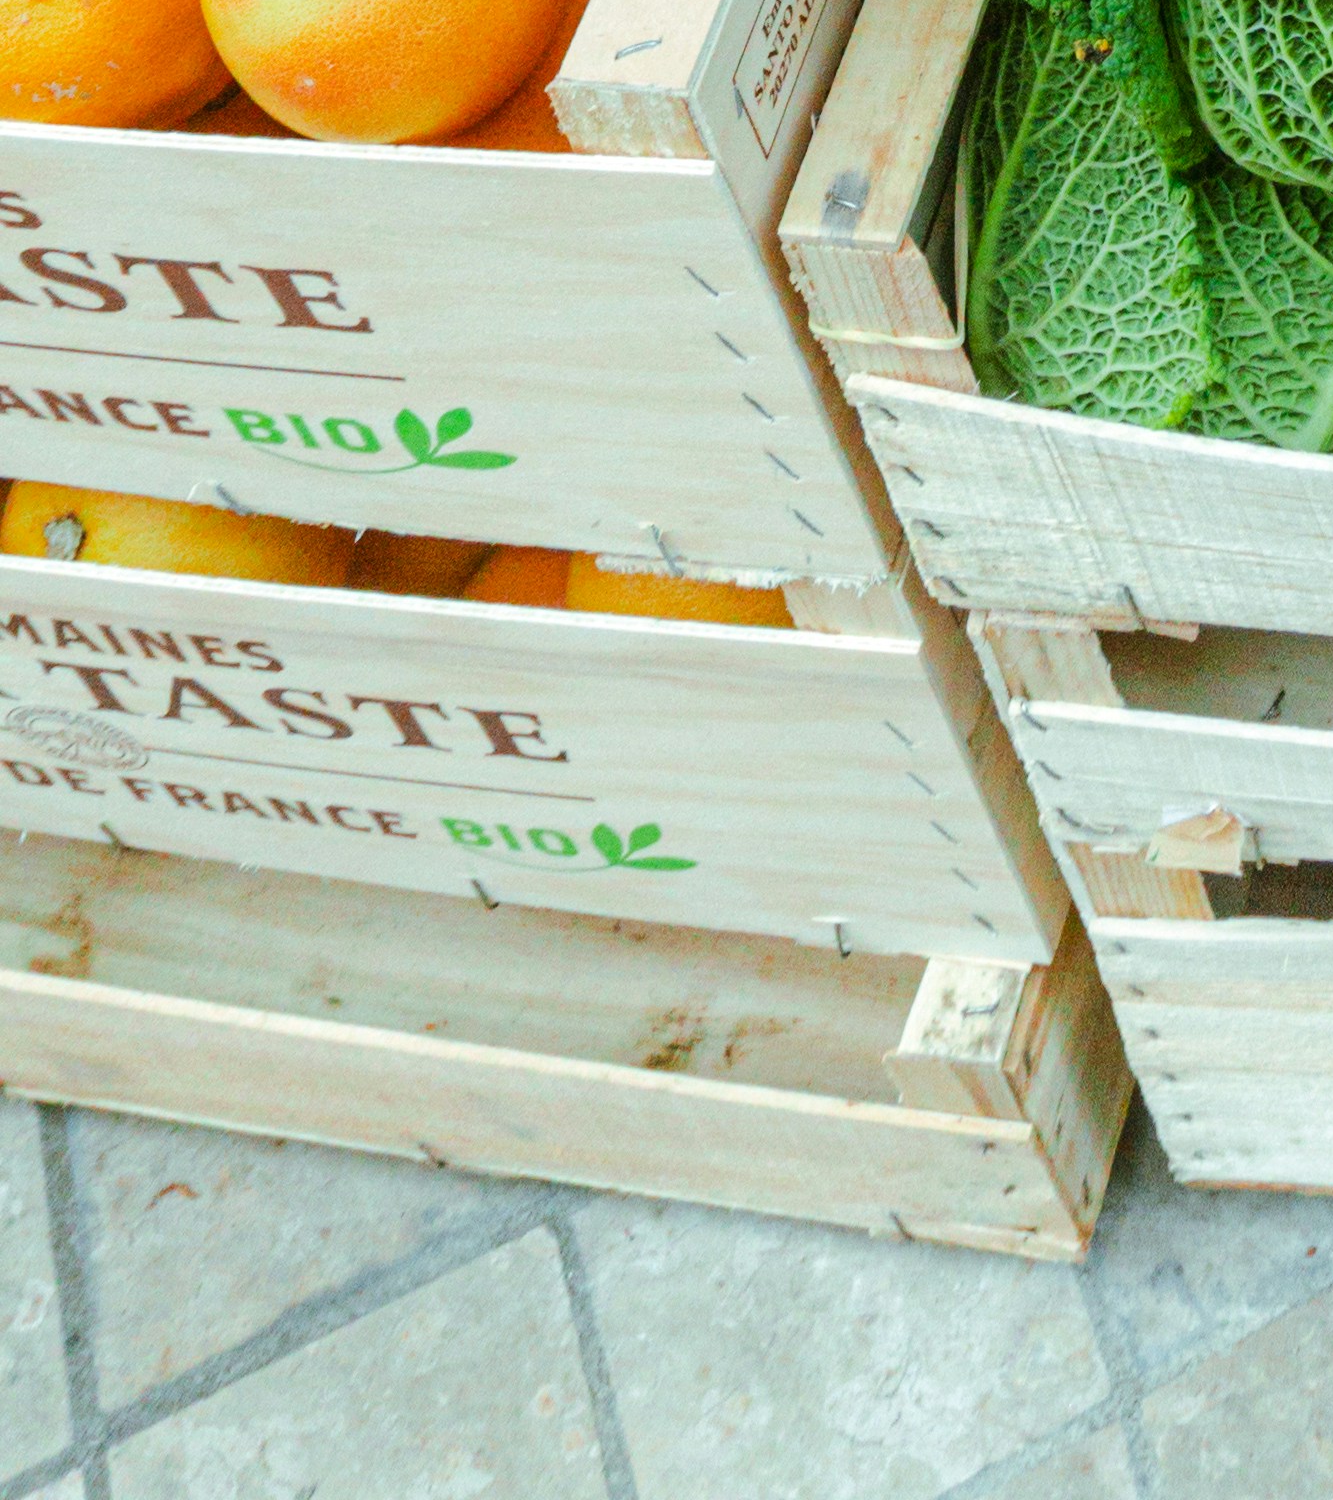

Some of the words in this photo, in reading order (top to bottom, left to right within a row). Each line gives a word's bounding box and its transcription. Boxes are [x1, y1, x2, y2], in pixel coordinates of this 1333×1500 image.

[754, 5, 793, 107] SANTO
[770, 33, 798, 109] 20270
[223, 407, 382, 454] BIO
[38, 659, 570, 764] TASTE
[1, 759, 105, 795] DE
[119, 776, 418, 839] FRANCE
[440, 816, 580, 858] BIO
